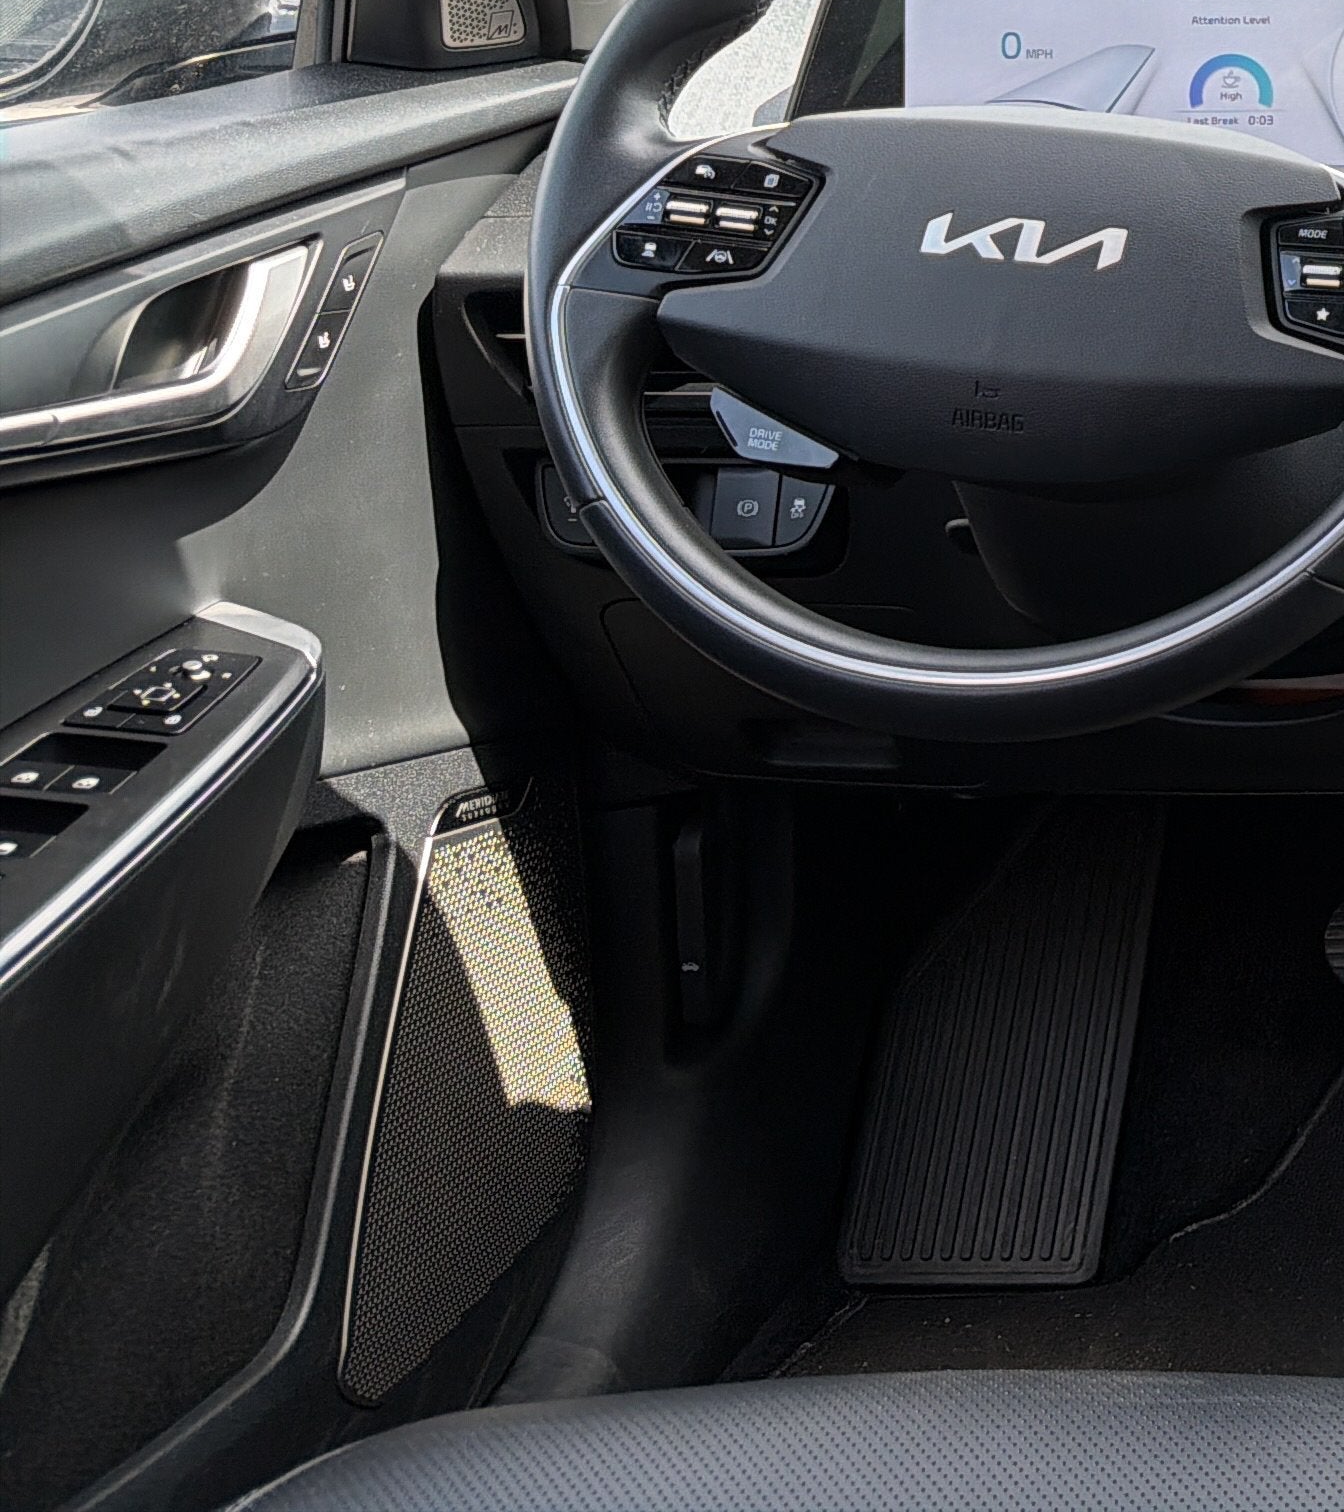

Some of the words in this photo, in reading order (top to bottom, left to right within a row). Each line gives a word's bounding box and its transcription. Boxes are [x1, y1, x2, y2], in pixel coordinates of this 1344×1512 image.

[1190, 15, 1241, 26] Attention
[1243, 16, 1271, 26] Level
[1001, 31, 1022, 61] 0
[1026, 47, 1054, 60] MPH
[1219, 90, 1243, 103] High
[1210, 115, 1240, 127] Break
[1247, 115, 1275, 127] 0:03
[1298, 228, 1329, 240] MODE
[951, 407, 1024, 432] AIRBAG
[748, 427, 784, 441] DRIVE
[746, 438, 780, 452] MODE
